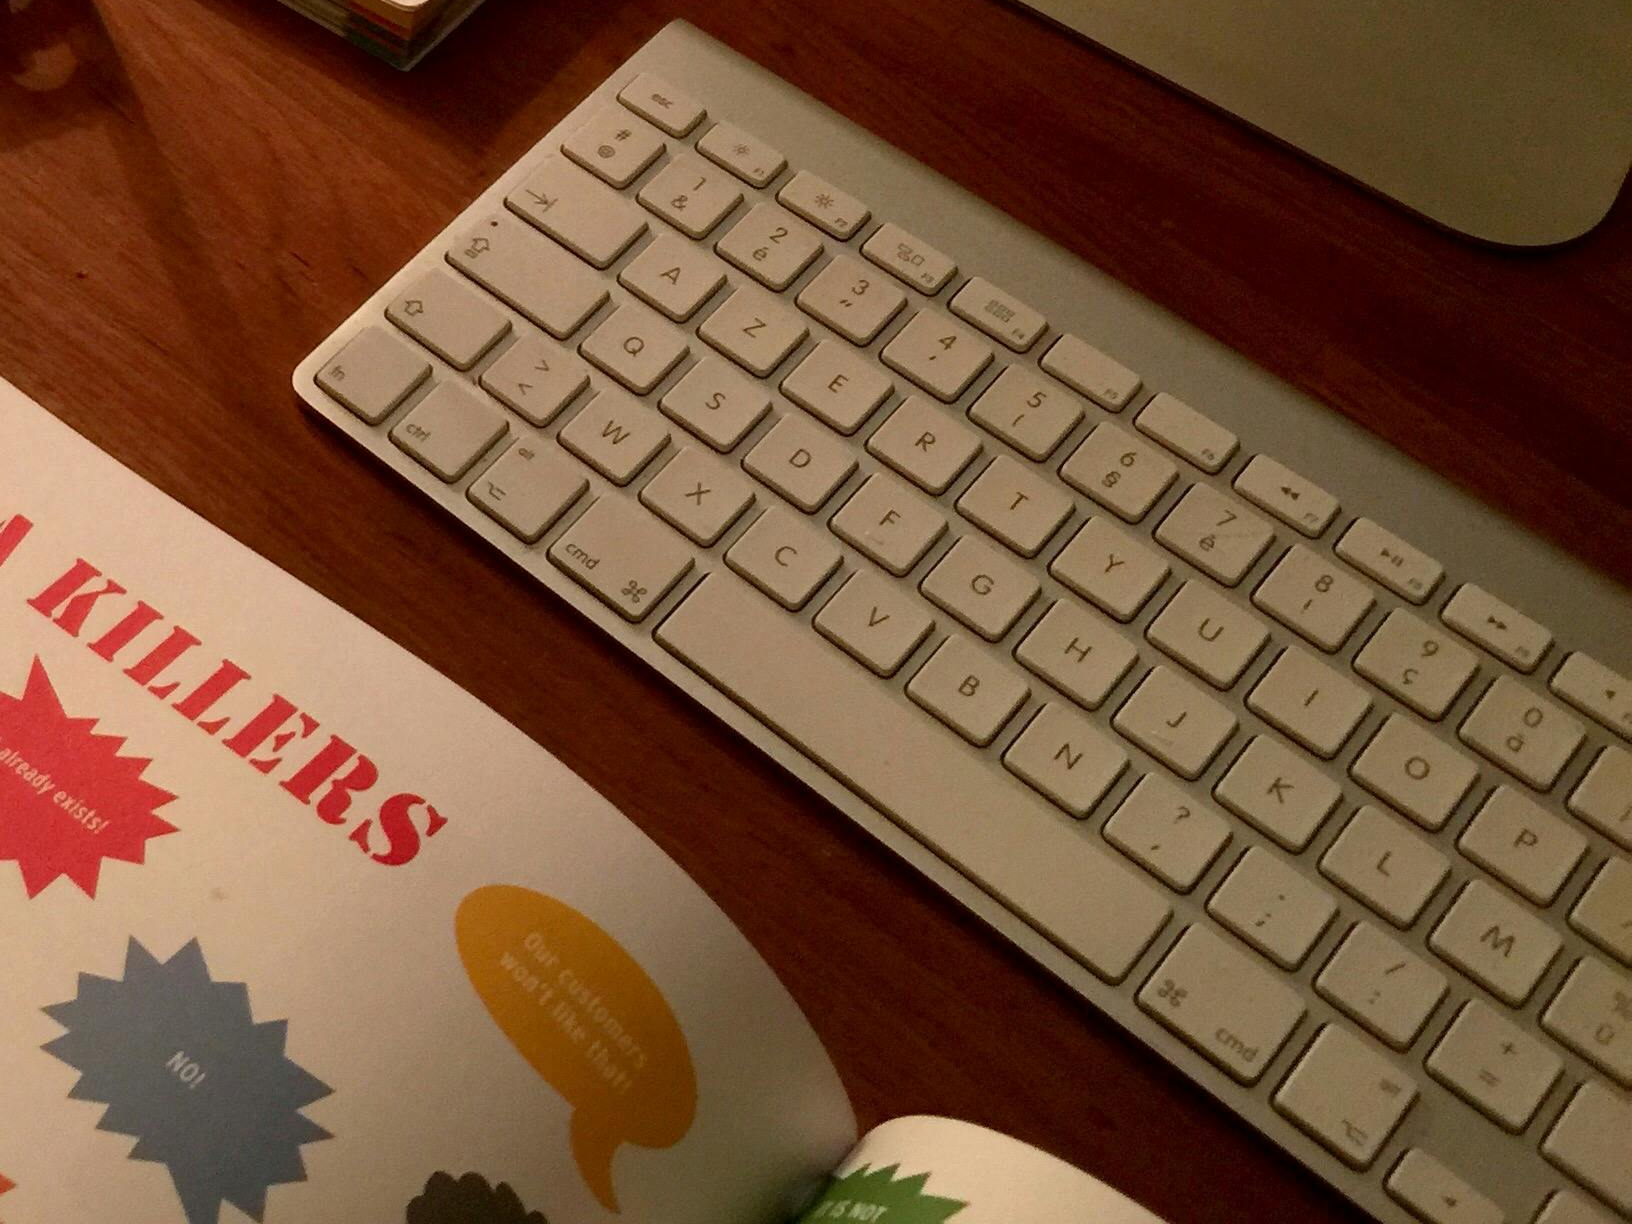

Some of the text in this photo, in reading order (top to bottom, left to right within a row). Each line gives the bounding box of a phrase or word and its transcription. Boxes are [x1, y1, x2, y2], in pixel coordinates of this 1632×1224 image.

[769, 227, 789, 244] 2
[659, 265, 682, 286] A
[851, 279, 870, 297] 3
[742, 317, 768, 338] Z
[622, 335, 646, 357] Q
[938, 334, 957, 352] 4
[827, 373, 849, 394] E
[704, 391, 726, 411] S
[1026, 391, 1047, 409] 5
[601, 419, 631, 446] W
[914, 431, 937, 452] R
[788, 447, 813, 469] D
[1120, 451, 1138, 467] 6
[685, 481, 712, 506] X
[1008, 490, 1030, 512] T
[879, 508, 902, 529] F
[1215, 509, 1238, 527] 7
[564, 542, 601, 572] cmd
[774, 545, 798, 568] C
[1102, 553, 1126, 575] Y
[970, 573, 995, 596] G
[1314, 574, 1335, 594] 8
[868, 605, 891, 629] V
[1197, 617, 1225, 643] U
[1064, 636, 1094, 664] H
[1420, 639, 1440, 658] 9
[957, 674, 981, 698] B
[26, 556, 449, 868] KILLERS
[1166, 710, 1189, 731] J
[1054, 741, 1084, 771] N
[1266, 776, 1295, 804] K
[53, 790, 111, 835] exists!
[1514, 826, 1540, 849] P
[1376, 850, 1393, 877] L
[1479, 923, 1516, 959] M
[523, 931, 648, 1069] Our customers
[1214, 1026, 1260, 1064] cmd
[165, 1050, 207, 1090] NO!
